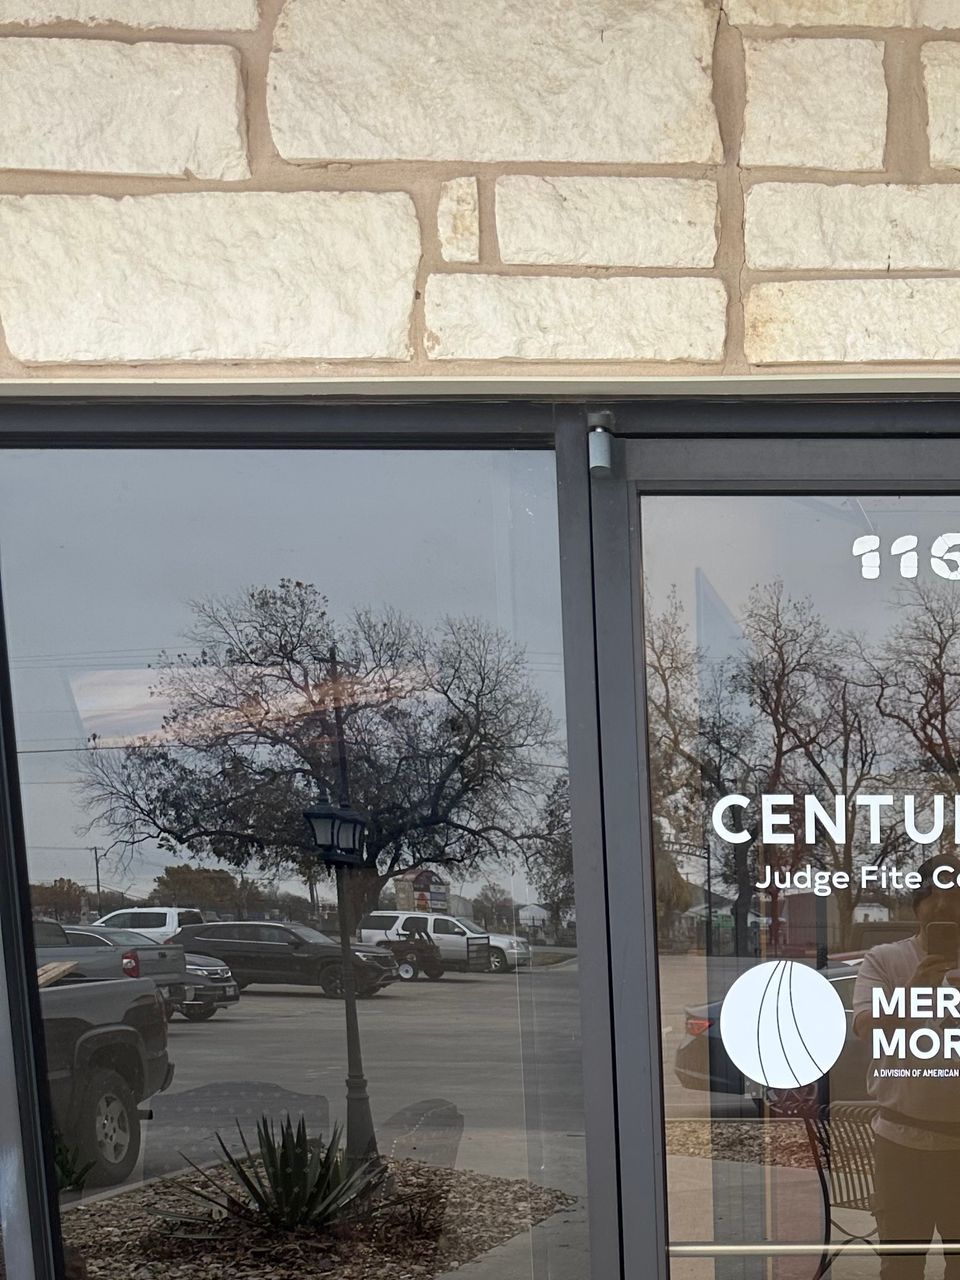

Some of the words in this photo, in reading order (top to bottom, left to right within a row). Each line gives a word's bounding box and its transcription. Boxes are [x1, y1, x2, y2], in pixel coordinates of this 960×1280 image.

[755, 864, 850, 897] Judge
[861, 865, 922, 889] Fite
[873, 1068, 880, 1078] A
[880, 1068, 911, 1078] DIVISION
[912, 1068, 922, 1078] OF
[923, 1068, 960, 1078] AMERICAN
